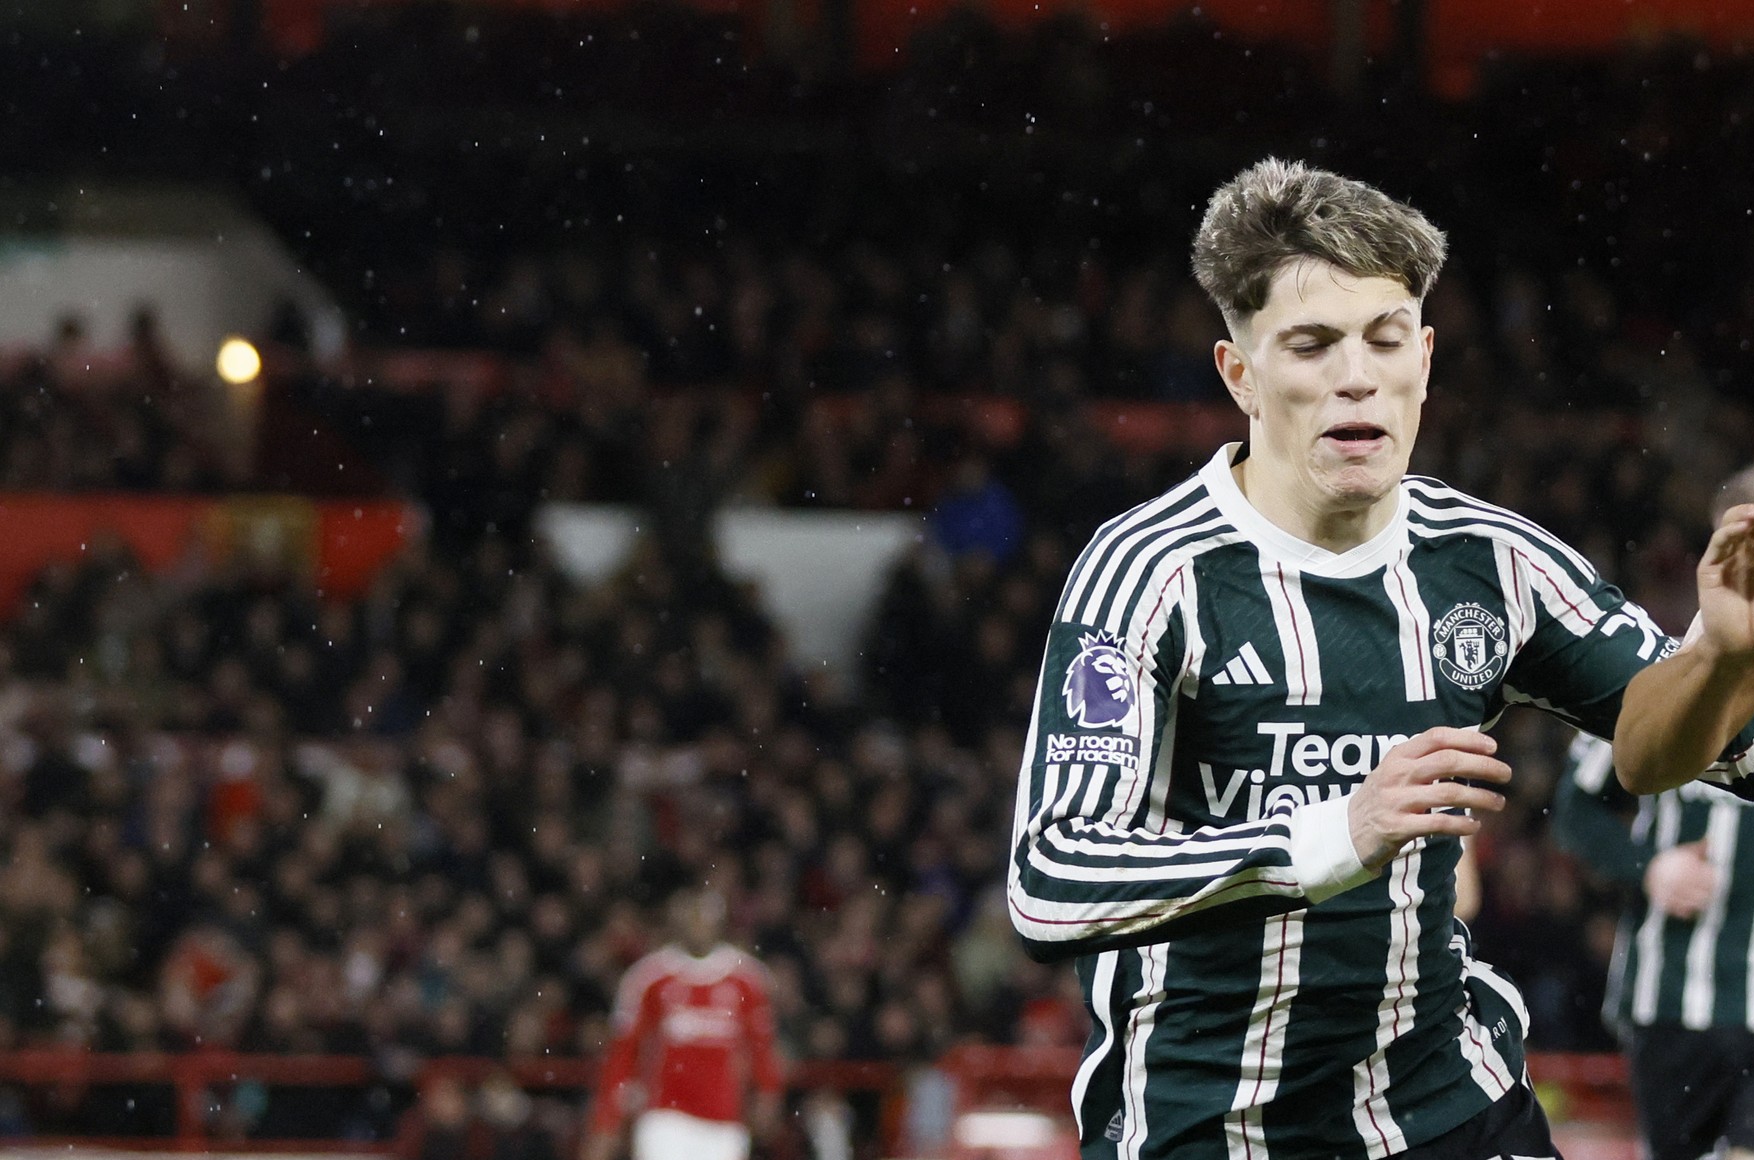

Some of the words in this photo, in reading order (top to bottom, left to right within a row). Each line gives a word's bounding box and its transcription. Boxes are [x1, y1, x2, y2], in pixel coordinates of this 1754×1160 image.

[1439, 609, 1502, 638] MANCHESTER
[1451, 668, 1493, 685] UNITED
[1047, 733, 1077, 750] No
[1079, 735, 1134, 753] room
[1045, 748, 1075, 763] for
[1076, 750, 1139, 770] racism
